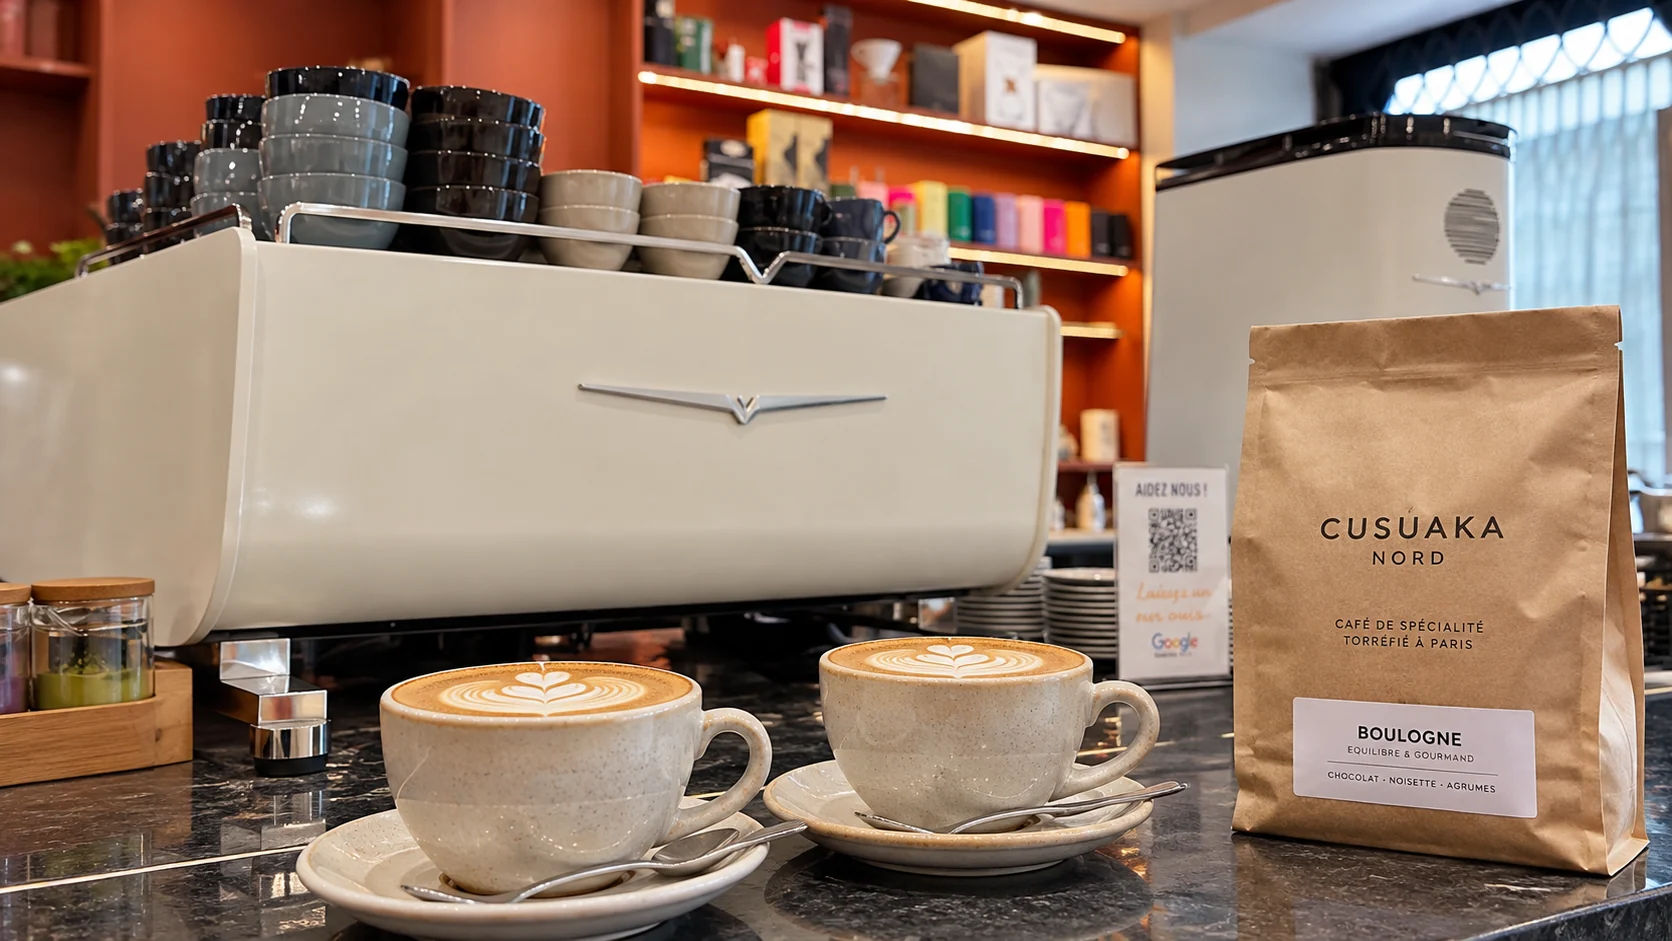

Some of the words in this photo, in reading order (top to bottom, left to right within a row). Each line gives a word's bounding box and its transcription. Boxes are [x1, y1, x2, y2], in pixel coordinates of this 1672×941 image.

[1135, 482, 1168, 497] AIDEZ
[1171, 482, 1201, 497] NOUS
[1372, 550, 1444, 566] NORD
[1334, 617, 1370, 630] CAFÉ
[1376, 620, 1394, 631] DE
[1400, 618, 1485, 634] SPÉCIALITÉ
[1151, 632, 1198, 653] Google
[1343, 634, 1409, 648] TORRÉFIÉ
[1415, 635, 1425, 648] À
[1431, 638, 1473, 650] PARIS
[1357, 725, 1462, 747] BOULOGNE
[1347, 745, 1400, 758] EQUILIBRE
[1404, 750, 1410, 758] &
[1414, 751, 1474, 763] GOURMAND
[1327, 771, 1379, 783] CHOCOLAT
[1389, 776, 1436, 788] NOISETTE
[1446, 782, 1496, 794] AGRUMES
